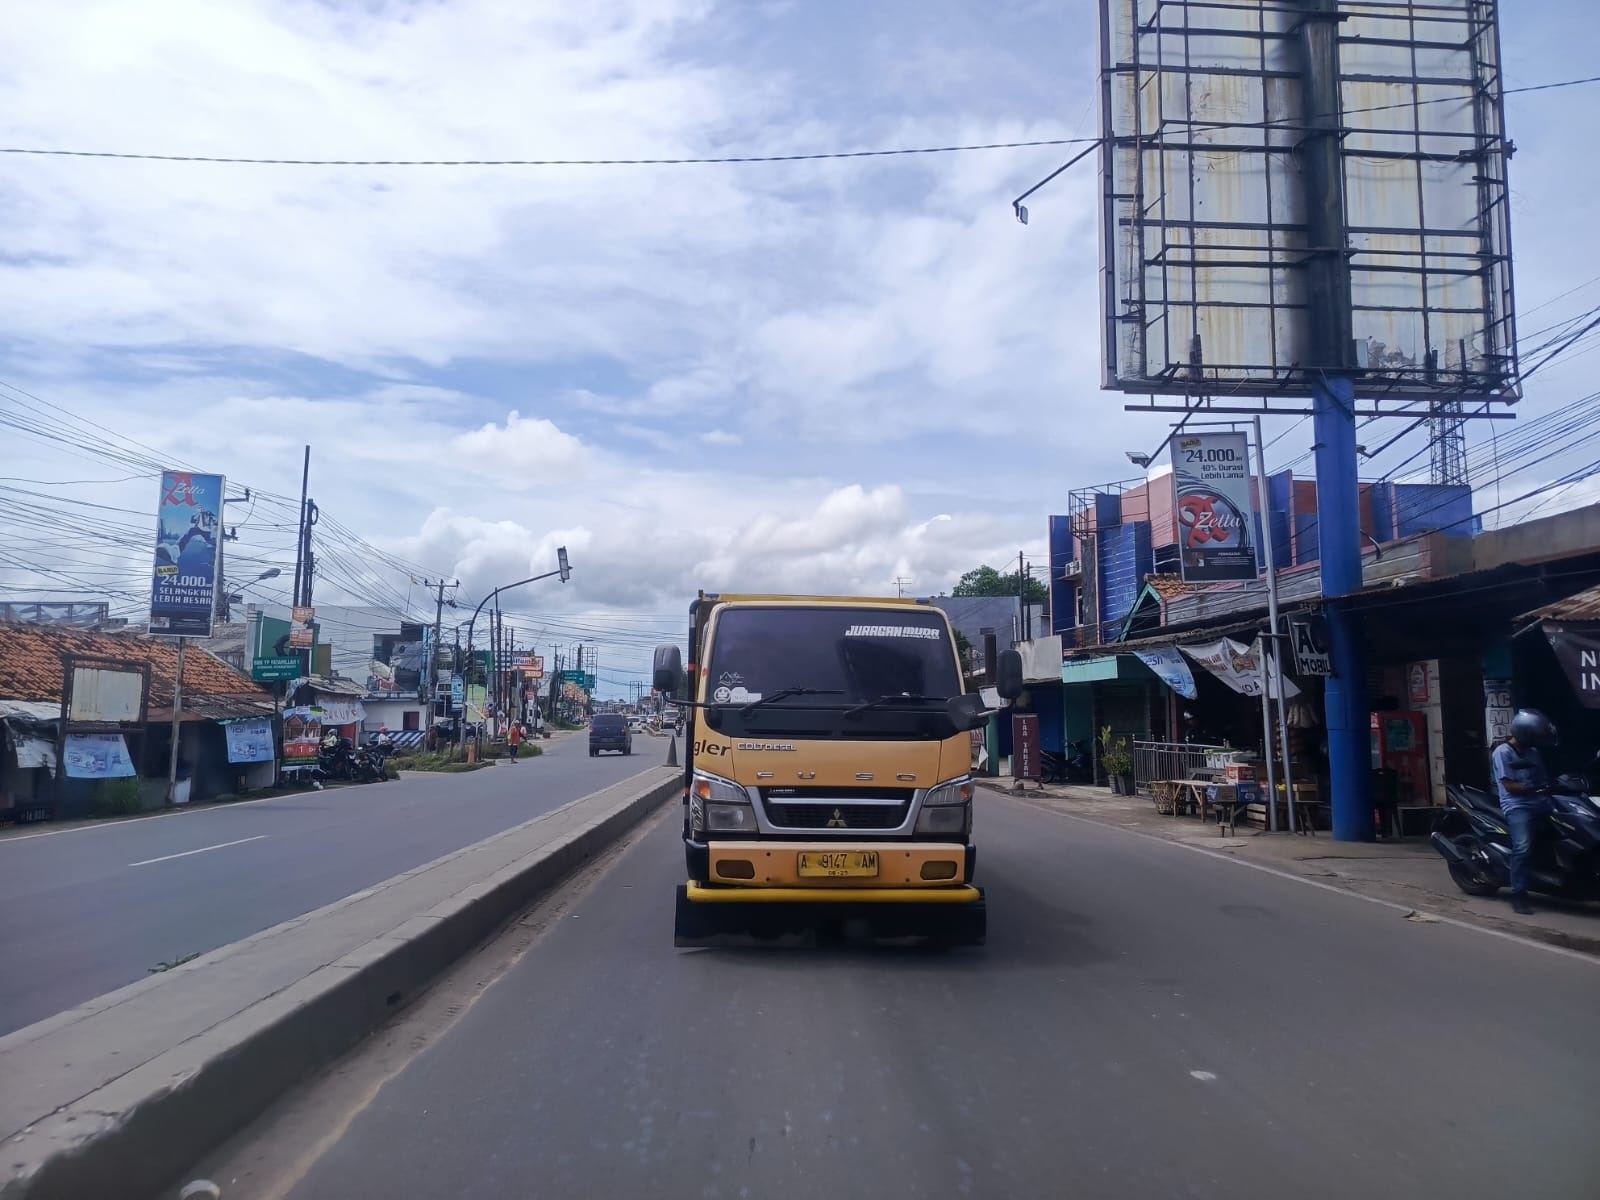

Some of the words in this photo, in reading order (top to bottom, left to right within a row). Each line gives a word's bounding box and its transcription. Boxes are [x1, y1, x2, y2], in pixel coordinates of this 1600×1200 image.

[1186, 448, 1235, 463] 24.000
[1218, 464, 1244, 472] Durasi
[1200, 471, 1221, 480] Lebih
[1222, 471, 1244, 479] Lama
[1195, 511, 1242, 529] Zetta
[160, 574, 206, 587] 24.000
[159, 587, 213, 597] SELANGKAH
[154, 594, 181, 604] LEBIH
[183, 596, 212, 605] BESAR
[1581, 650, 1600, 667] N
[756, 770, 917, 782] FUSO
[800, 855, 808, 868] A
[822, 853, 848, 869] 9147
[861, 854, 876, 868] AM
